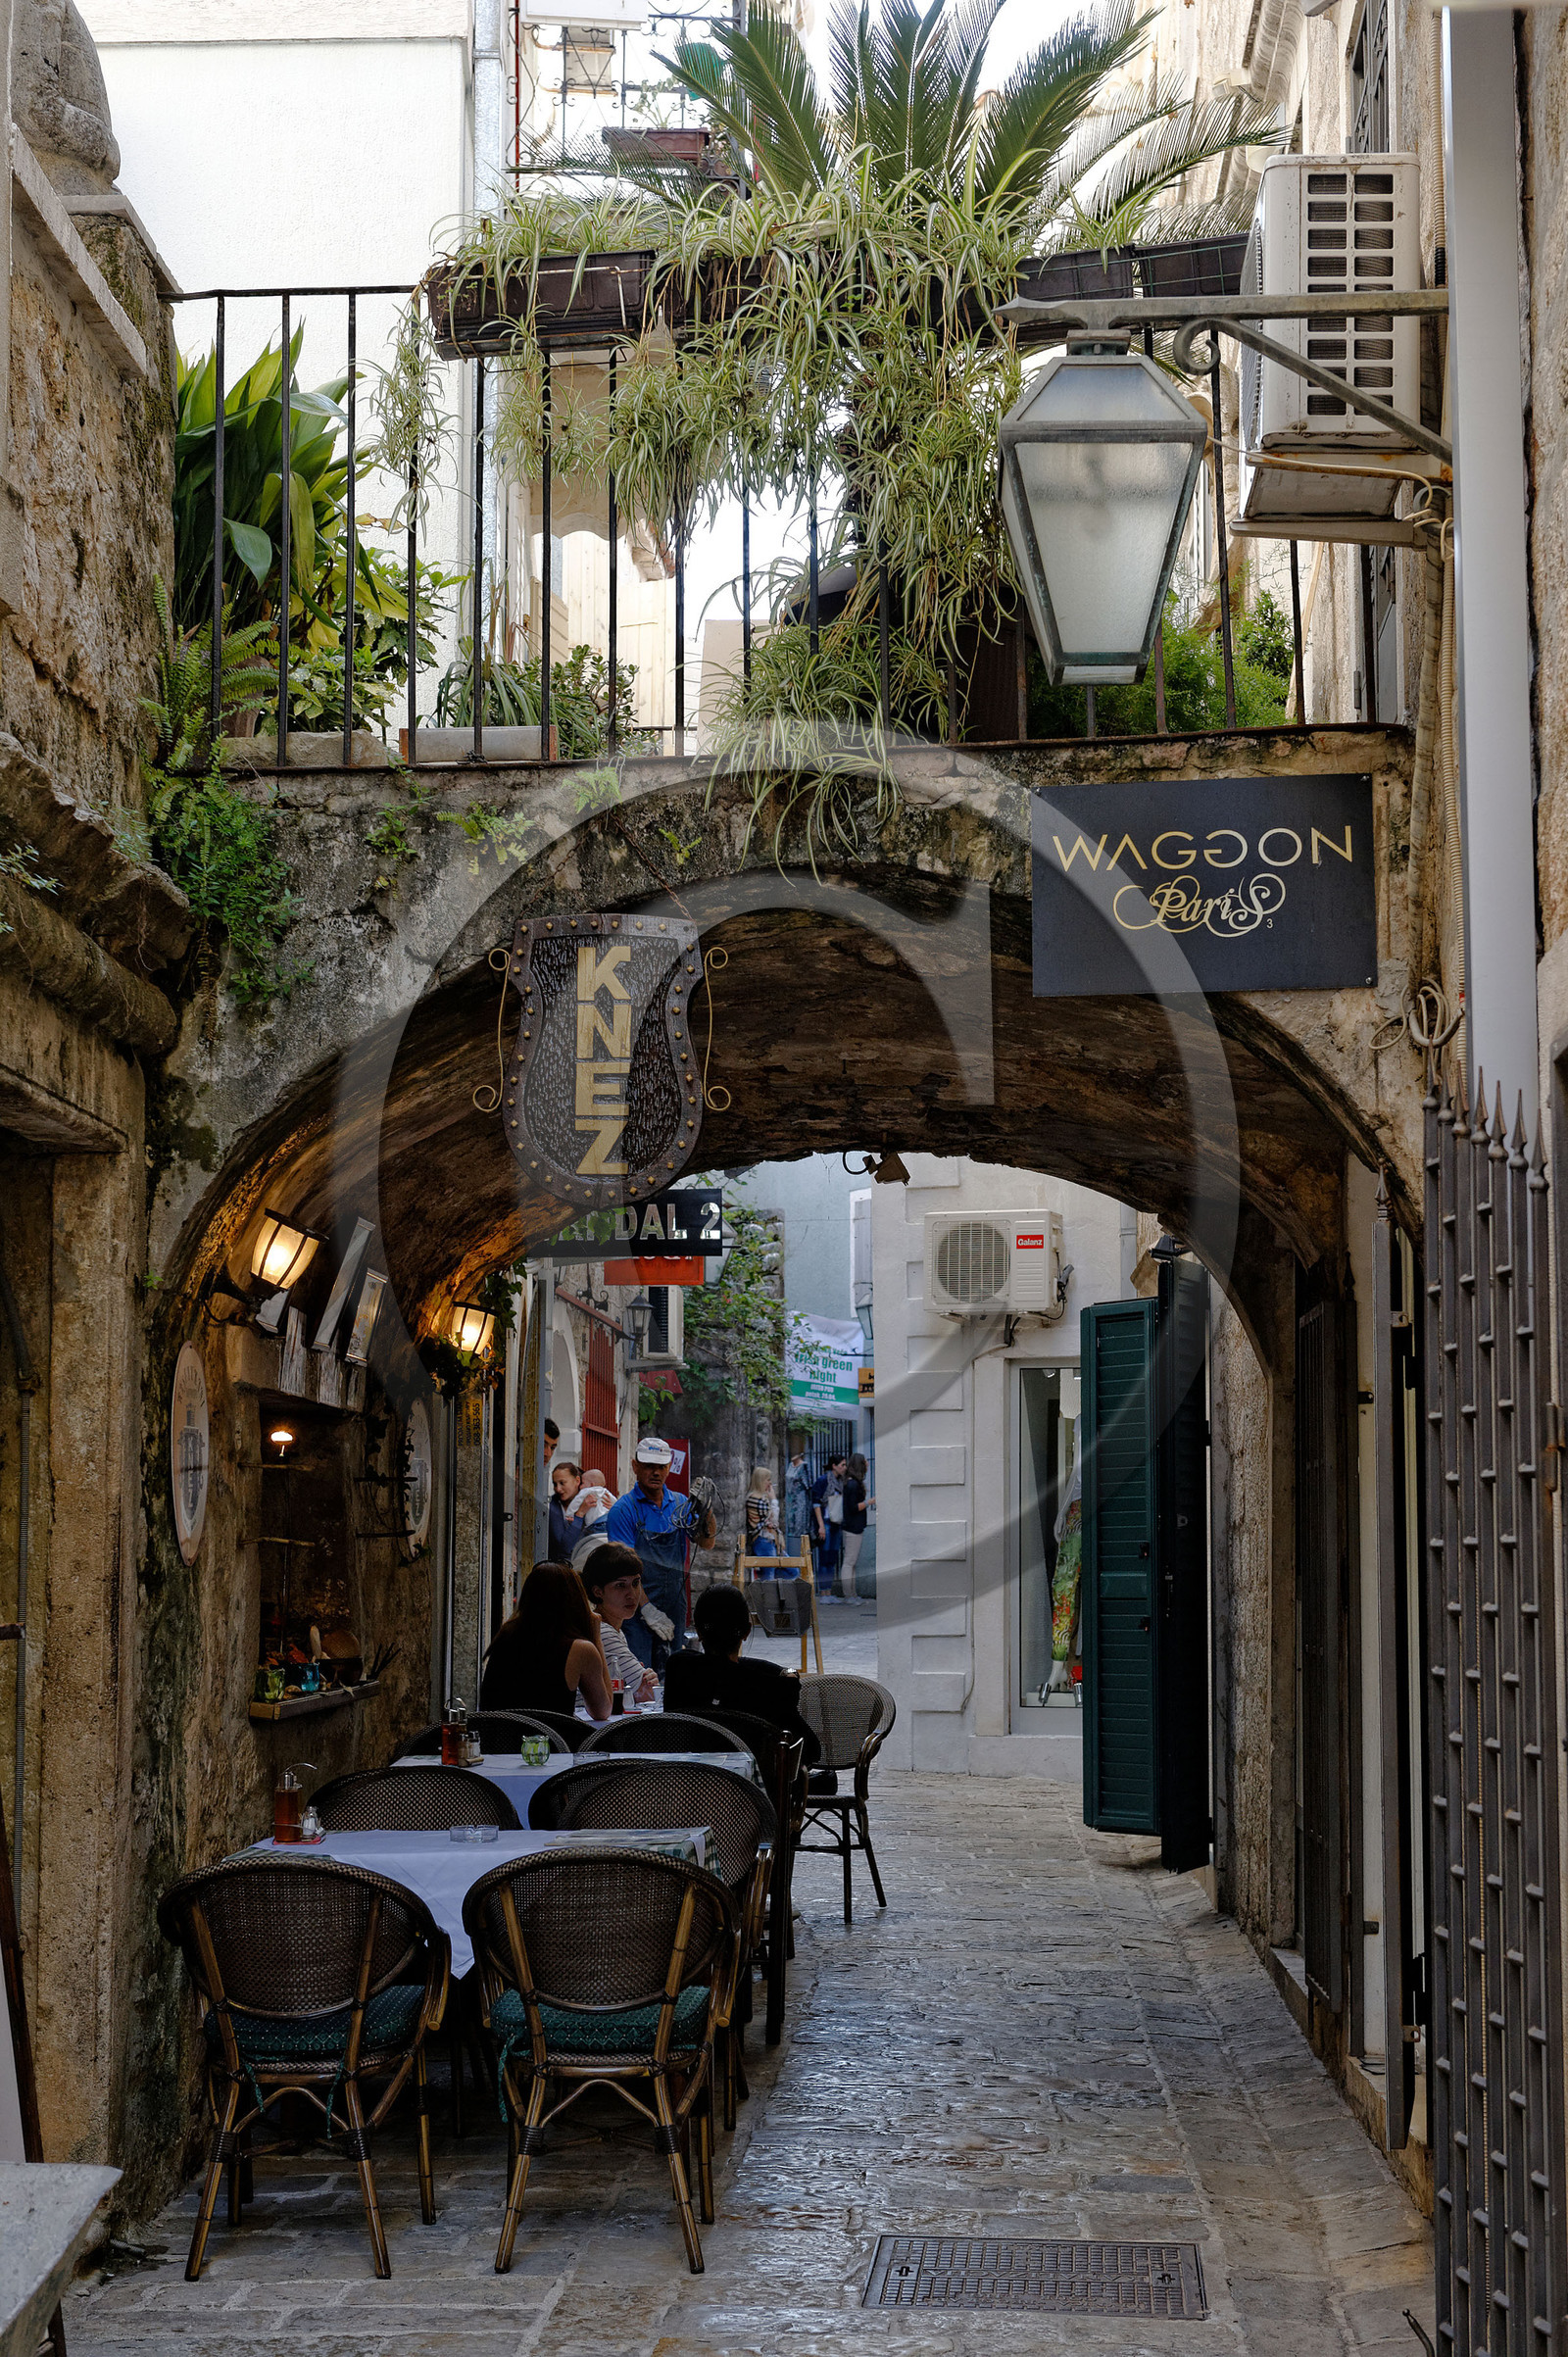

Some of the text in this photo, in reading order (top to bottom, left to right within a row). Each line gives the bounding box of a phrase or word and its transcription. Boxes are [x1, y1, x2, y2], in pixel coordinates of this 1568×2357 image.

[1053, 825, 1353, 872] WAGGON
[574, 946, 631, 1175] KNEZ
[700, 1202, 721, 1240] 2
[1017, 1238, 1043, 1247] Galanz
[809, 1368, 837, 1383] night
[822, 1356, 853, 1371] green
[472, 1402, 481, 1447] 068-363-565
